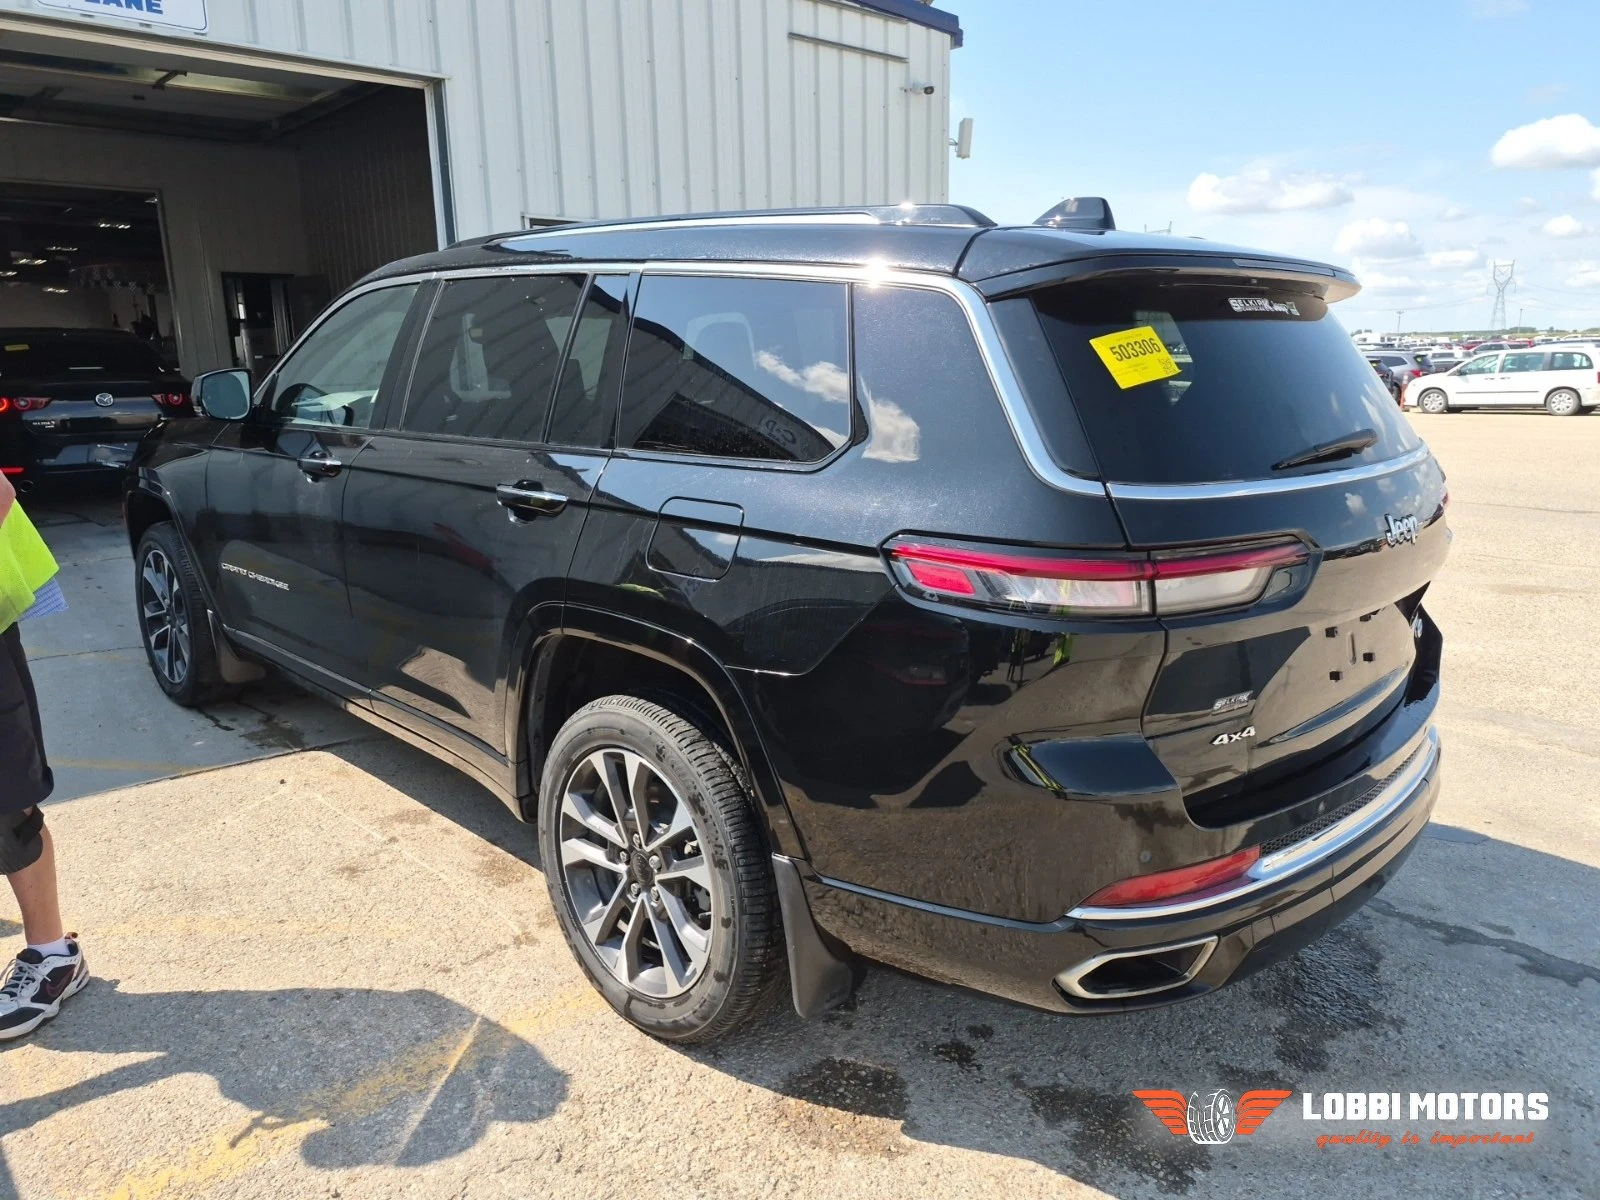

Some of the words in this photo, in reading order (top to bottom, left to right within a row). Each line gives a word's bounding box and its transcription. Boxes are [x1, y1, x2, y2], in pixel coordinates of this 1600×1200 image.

[84, 0, 164, 15] NE
[1110, 338, 1161, 361] 503306
[1384, 513, 1417, 547] Jeep
[1210, 725, 1256, 745] 4x4
